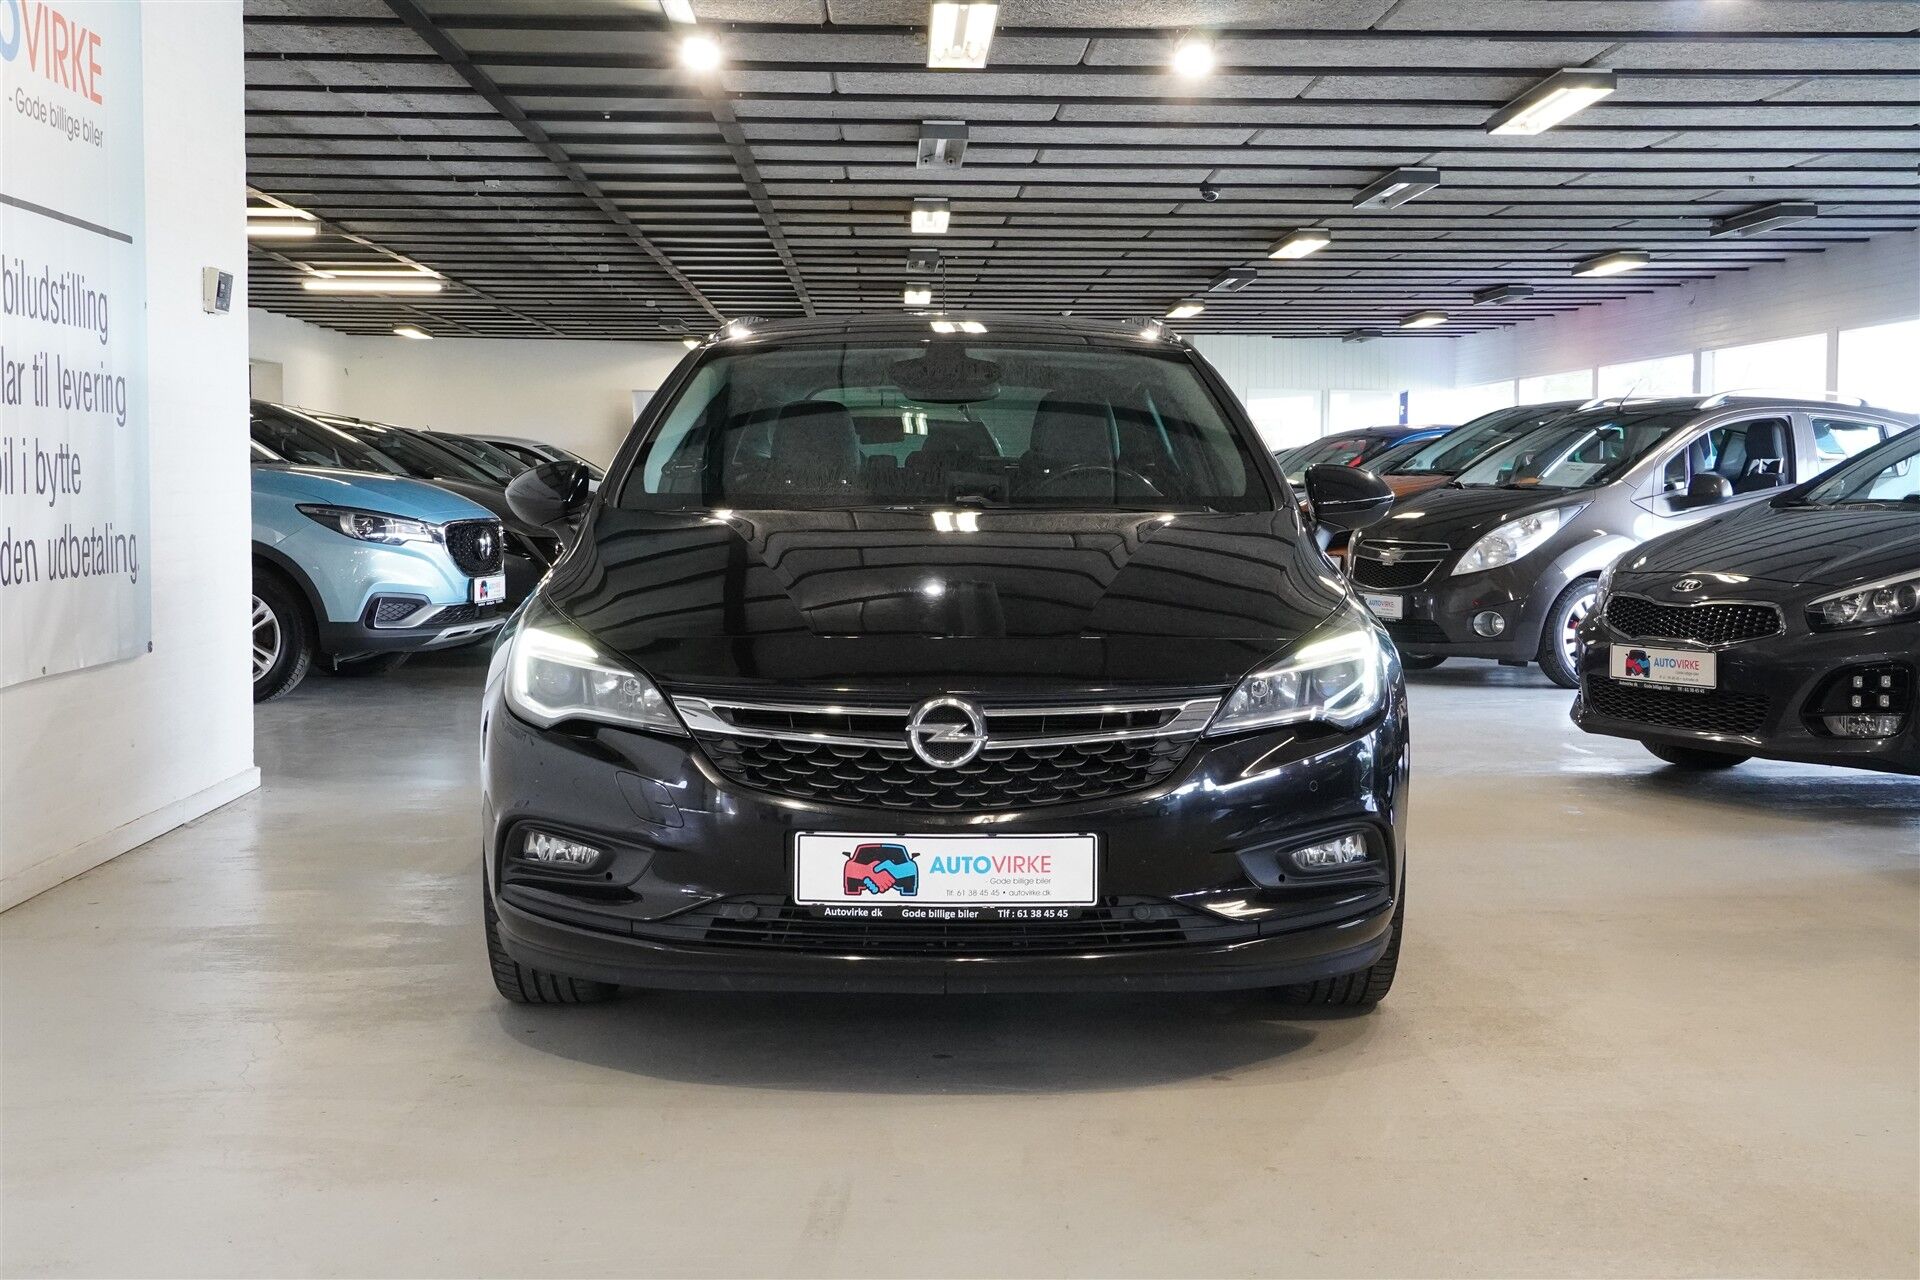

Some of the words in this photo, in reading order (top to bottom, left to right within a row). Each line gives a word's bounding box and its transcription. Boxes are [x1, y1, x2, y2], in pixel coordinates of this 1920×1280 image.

[15, 87, 47, 123] Gode
[50, 102, 80, 141] billige
[83, 117, 103, 148] biler
[1, 254, 108, 345] biludstilling
[1, 346, 25, 405] lar
[33, 351, 48, 407] til
[57, 354, 126, 427] levering
[0, 437, 13, 494] il
[23, 437, 27, 494] i
[35, 437, 81, 507] bytte
[1, 527, 38, 586] den
[1654, 658, 1699, 670] AUTOVIRKE
[929, 855, 1051, 874] AUTOVIRKE
[1013, 877, 1034, 886] billige
[1035, 877, 1051, 885] biler
[1009, 889, 1051, 897] autovirke.dk
[824, 907, 869, 917] Autovirke
[871, 908, 883, 917] dk
[902, 909, 926, 918] Gode
[928, 909, 955, 920] billige
[957, 909, 979, 918] biler
[998, 909, 1010, 918] Tlf
[1017, 909, 1028, 918] 61
[1030, 909, 1042, 918] 38
[1043, 909, 1055, 918] 45
[1057, 909, 1069, 918] 45
